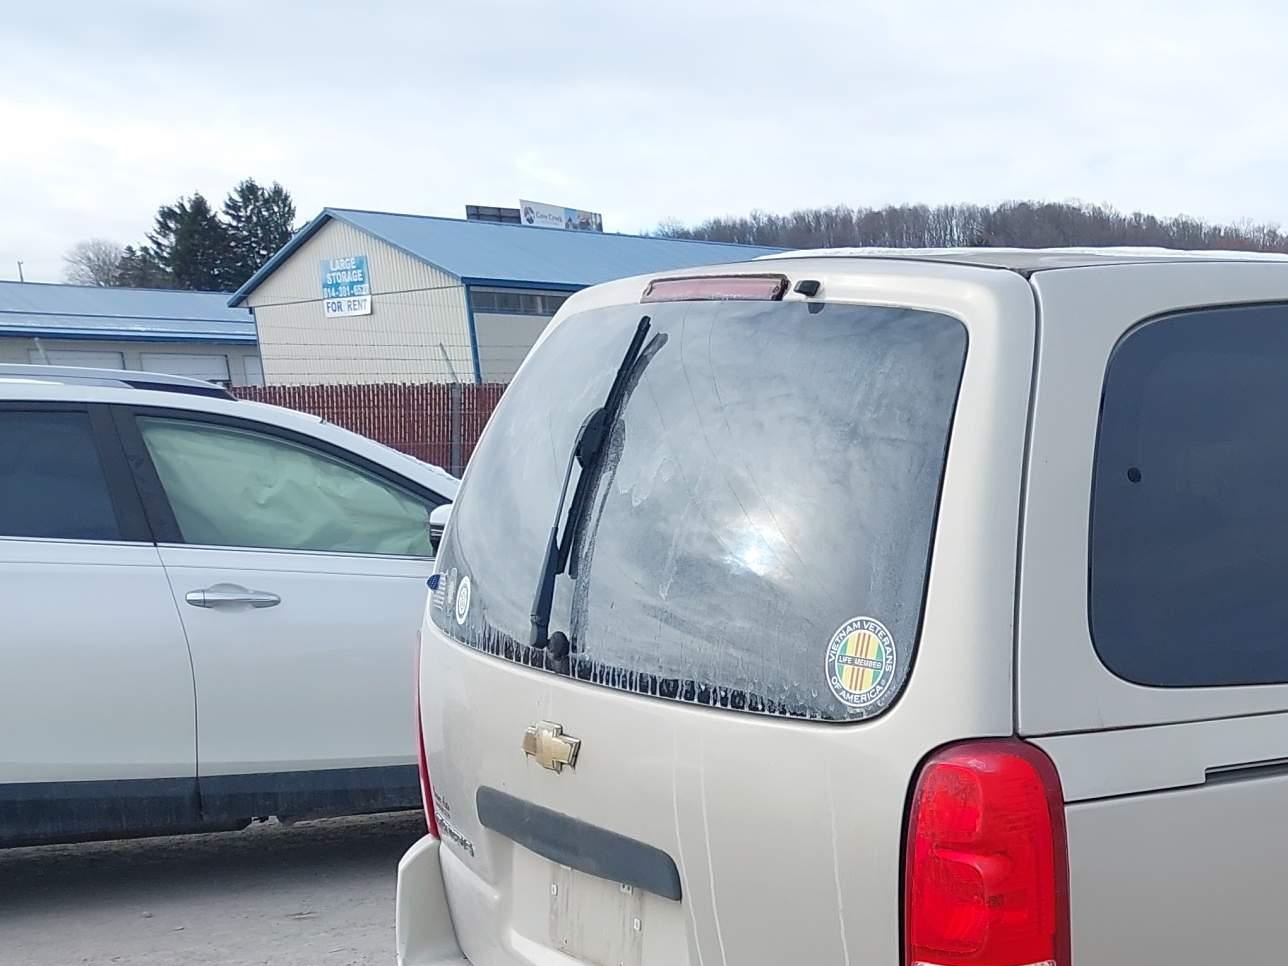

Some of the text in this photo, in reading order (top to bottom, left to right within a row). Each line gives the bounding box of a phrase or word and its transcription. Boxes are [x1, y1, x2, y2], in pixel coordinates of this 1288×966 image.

[330, 258, 357, 271] LARGE
[327, 270, 364, 284] STORAGE
[326, 299, 368, 313] FOR RENT
[828, 621, 893, 673] VIETNAM VETERANS
[838, 656, 882, 669] LIFE MEMBER
[831, 676, 884, 703] OF AMERICA
